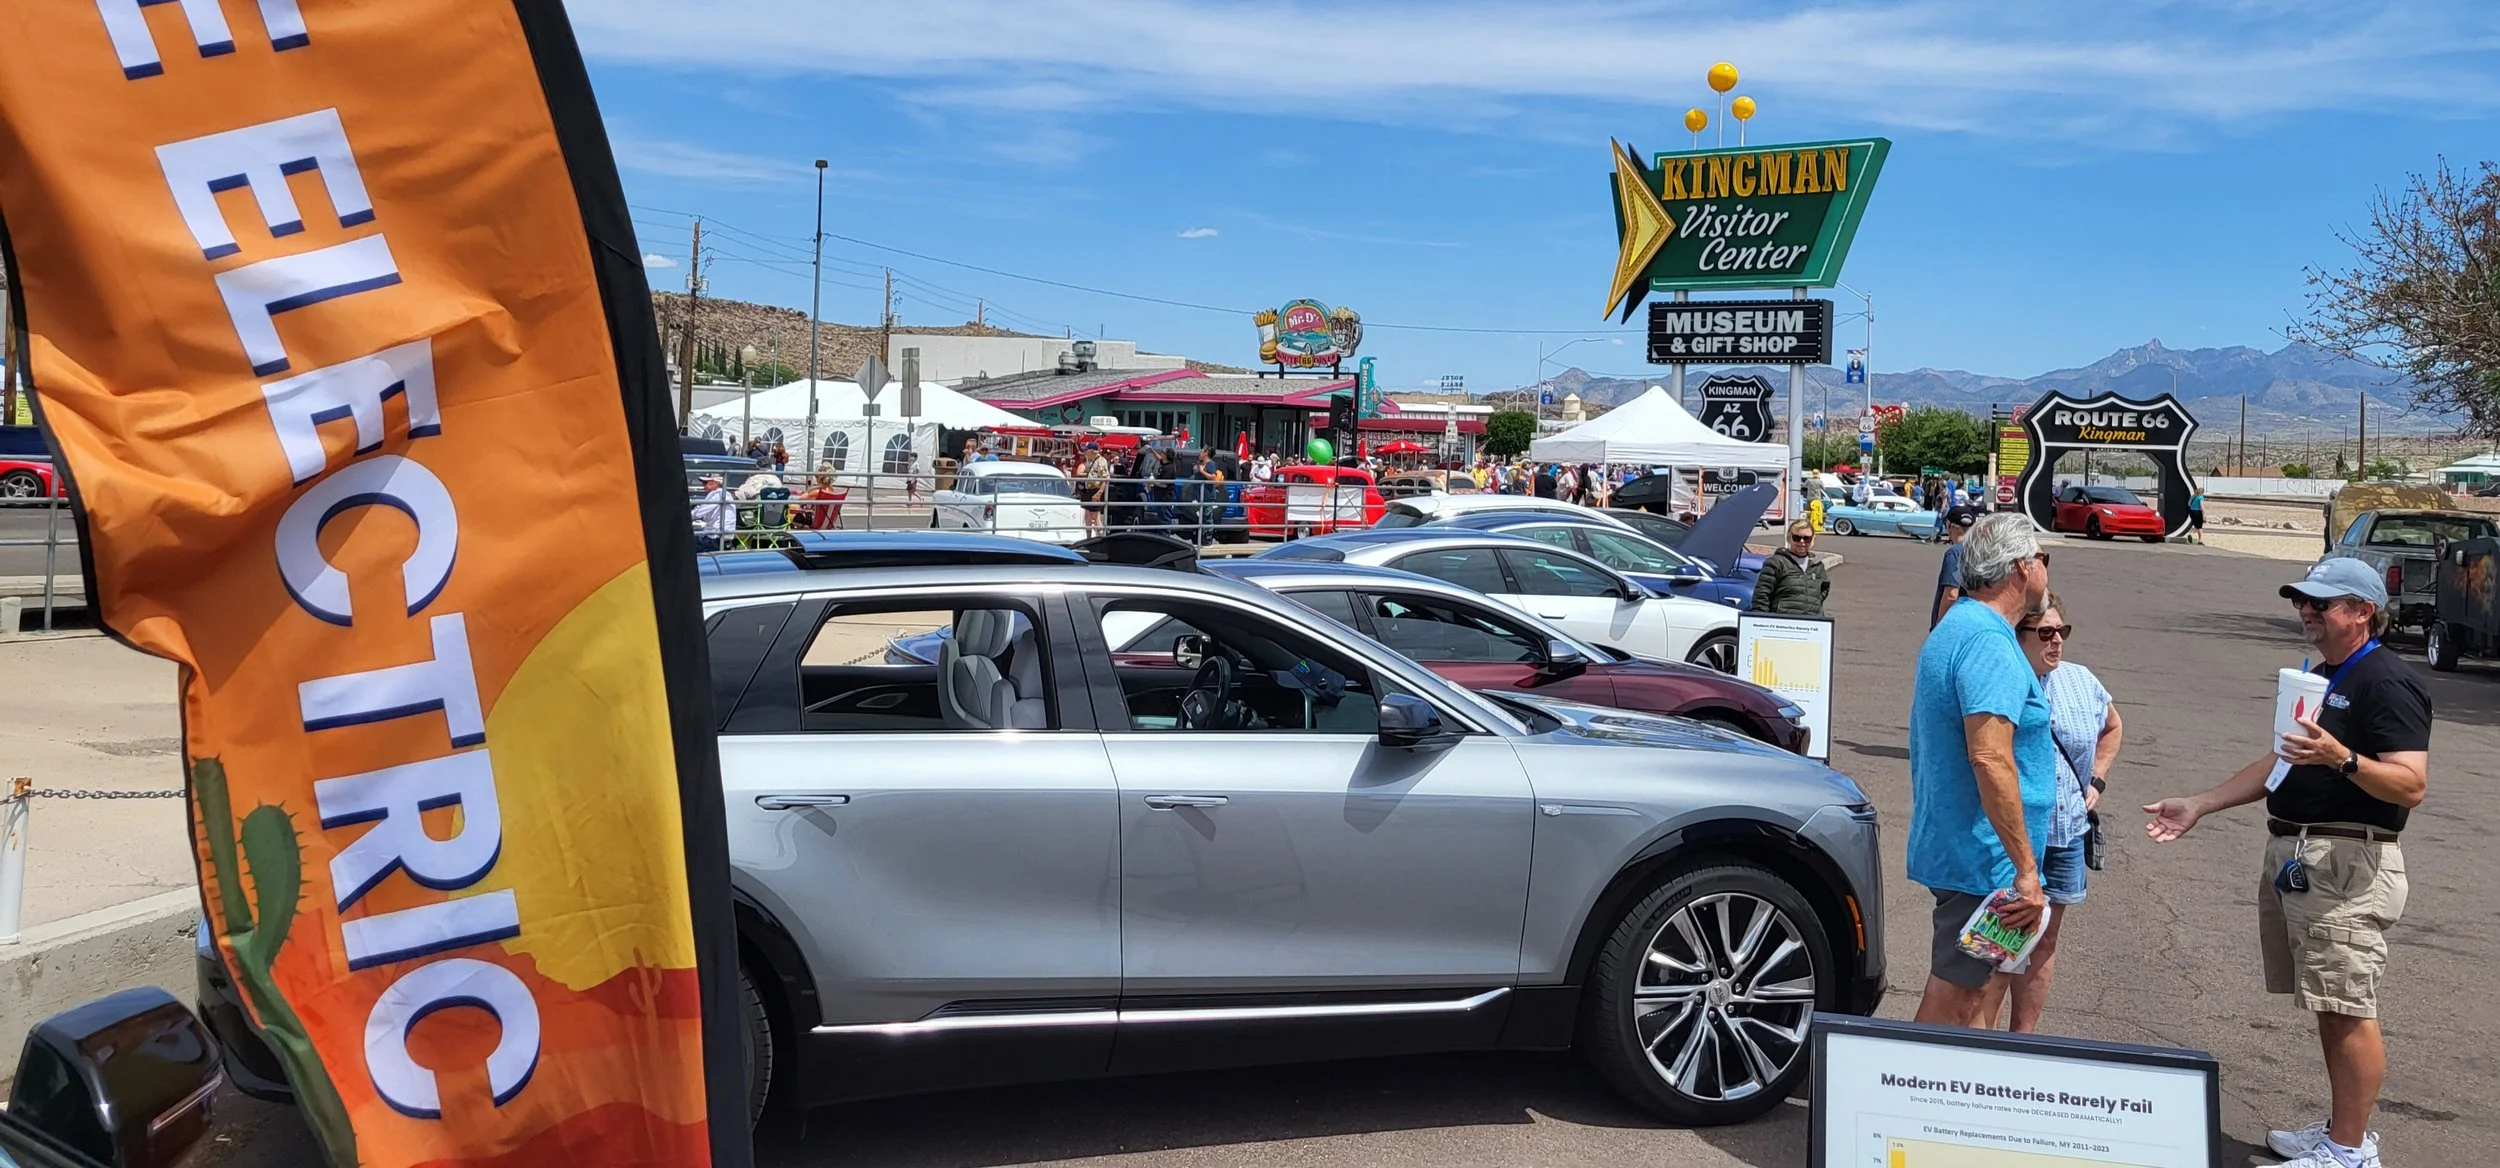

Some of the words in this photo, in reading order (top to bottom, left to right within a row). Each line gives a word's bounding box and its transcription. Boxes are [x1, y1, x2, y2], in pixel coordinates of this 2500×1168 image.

[1661, 148, 1849, 200] KINGMAN
[1680, 203, 1789, 239] Visitor
[1699, 237, 1807, 271] Center
[1666, 311, 1804, 334] MUSEUM
[1671, 336, 1687, 353] &
[1691, 336, 1735, 353] GIFT
[1739, 336, 1797, 353] SHOP
[1708, 386, 1756, 395] KINGMAN
[1723, 402, 1741, 413] AZ
[2054, 410, 2138, 427] ROUTE
[2141, 412, 2170, 428] 66
[1712, 414, 1750, 437] 66
[2078, 426, 2146, 443] Kingman
[1703, 483, 1751, 493] WELCOM
[154, 107, 541, 1120] ELECTRIC
[1881, 1072, 1947, 1092] Modern
[1950, 1080, 1971, 1094] EV
[1975, 1083, 2055, 1103] Batteries
[2059, 1091, 2117, 1114] Rarely
[2120, 1098, 2153, 1114] Fail
[1910, 1096, 1928, 1104] Since
[1946, 1099, 1970, 1109] battery
[1971, 1102, 1993, 1110] failure
[1994, 1105, 2011, 1113] rates
[2031, 1108, 2069, 1119] DECREASED
[1934, 1127, 1958, 1137] Battery
[1960, 1130, 2007, 1141] Replacements
[2008, 1135, 2022, 1143] Due
[2032, 1138, 2057, 1148] Failure,
[2059, 1140, 2070, 1149] MY
